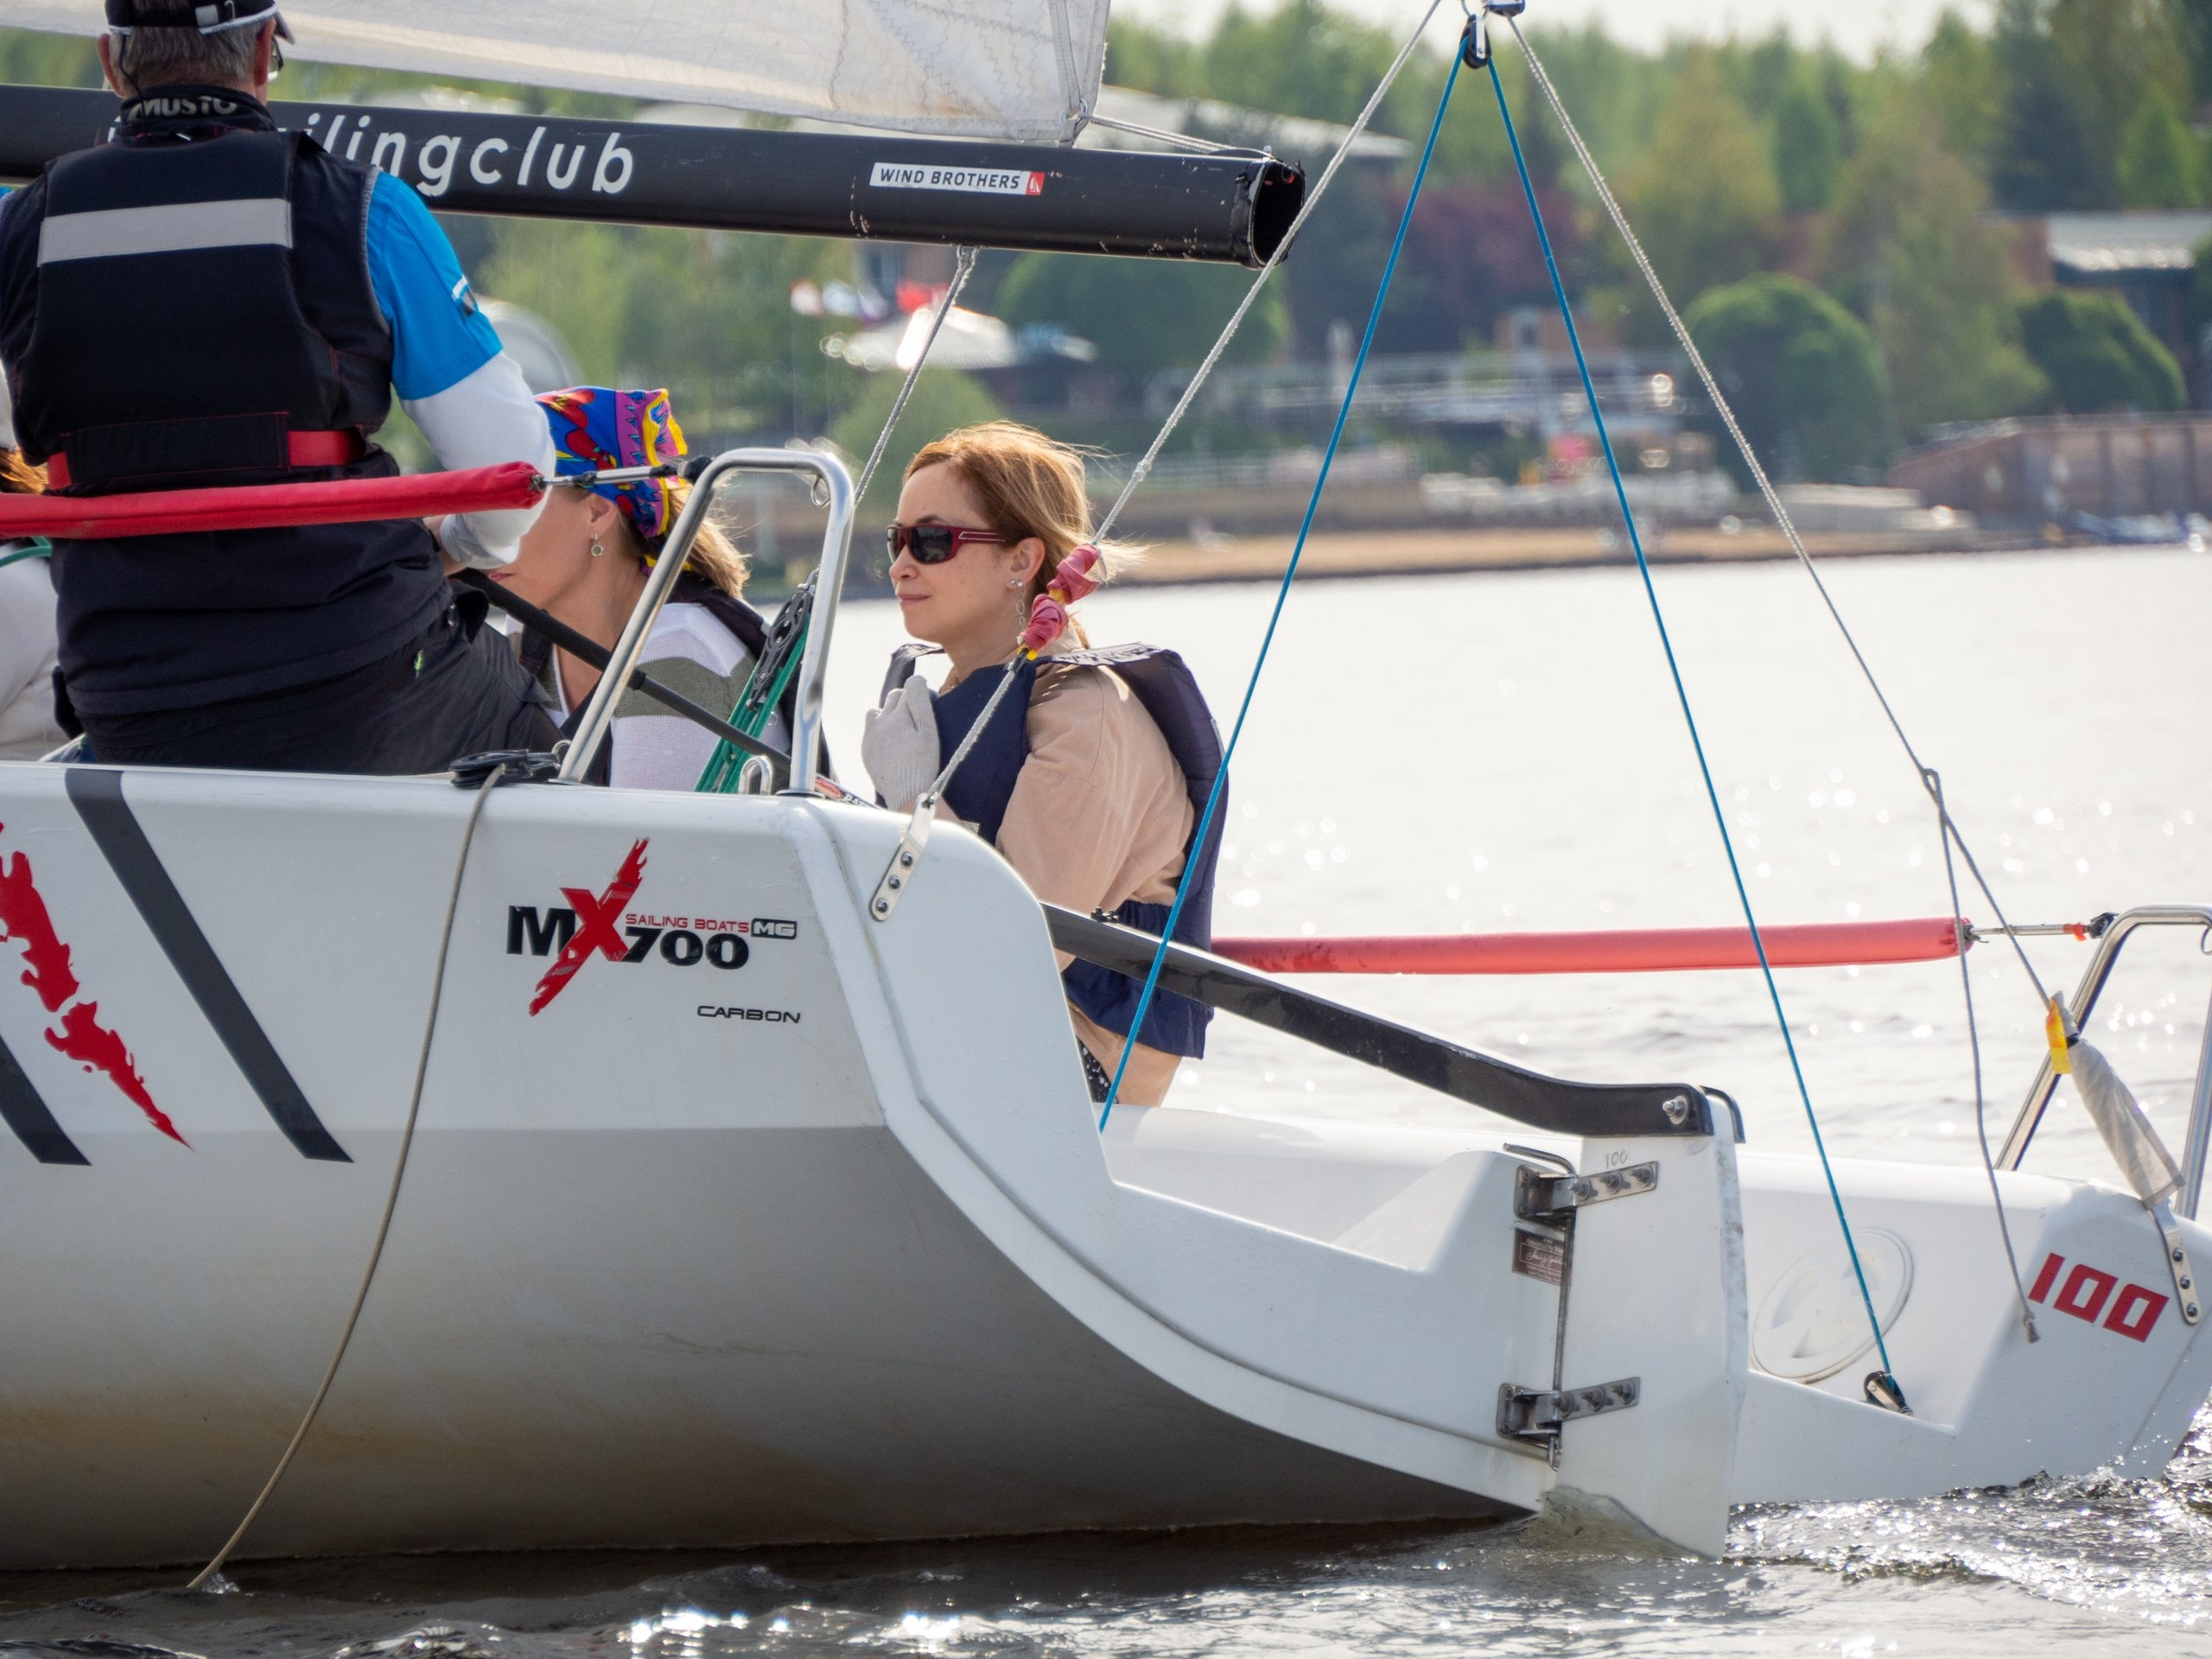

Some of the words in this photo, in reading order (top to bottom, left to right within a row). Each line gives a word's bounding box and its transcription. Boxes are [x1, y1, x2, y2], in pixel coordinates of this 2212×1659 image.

[127, 95, 237, 122] MUSTO
[880, 168, 925, 184] WIND
[931, 171, 1021, 189] BROTHERS
[625, 913, 689, 929] SAILING
[694, 918, 749, 933] BOATS
[753, 920, 796, 938] MG
[696, 1005, 800, 1024] CARBON
[2028, 1252, 2170, 1344] 100
